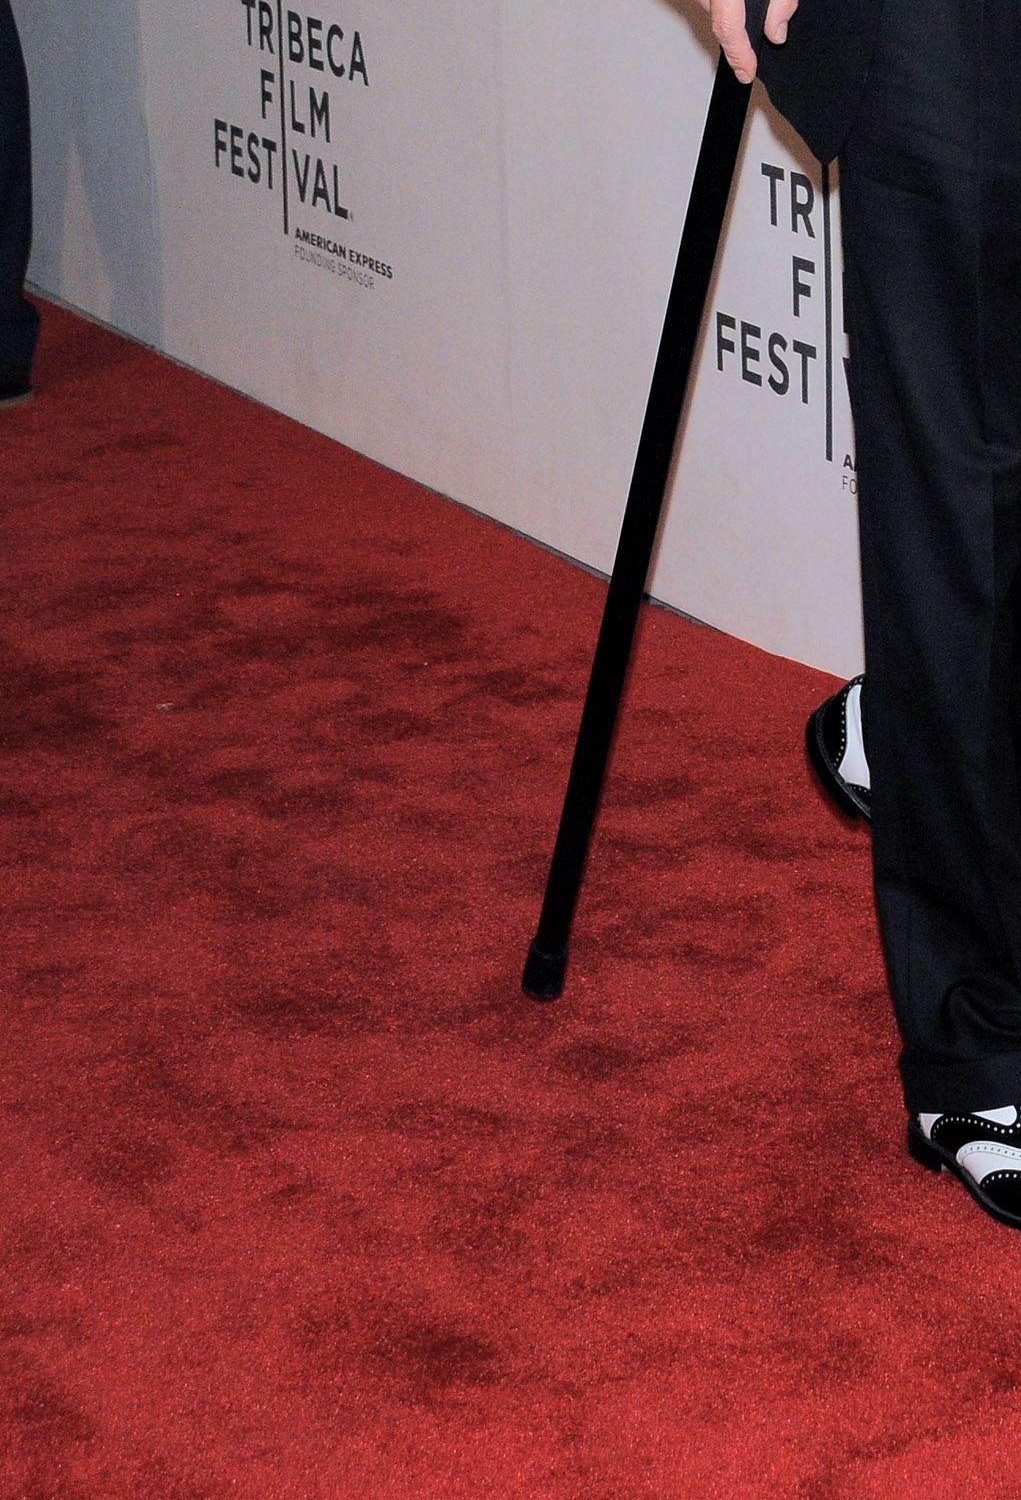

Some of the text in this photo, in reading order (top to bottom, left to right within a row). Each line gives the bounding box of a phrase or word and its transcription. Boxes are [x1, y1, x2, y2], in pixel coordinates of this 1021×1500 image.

[260, 68, 331, 143] FILM
[213, 118, 349, 220] FESTIVAL
[294, 227, 394, 279] AMERICAN EXPRESS
[337, 261, 375, 290] SPONSOR
